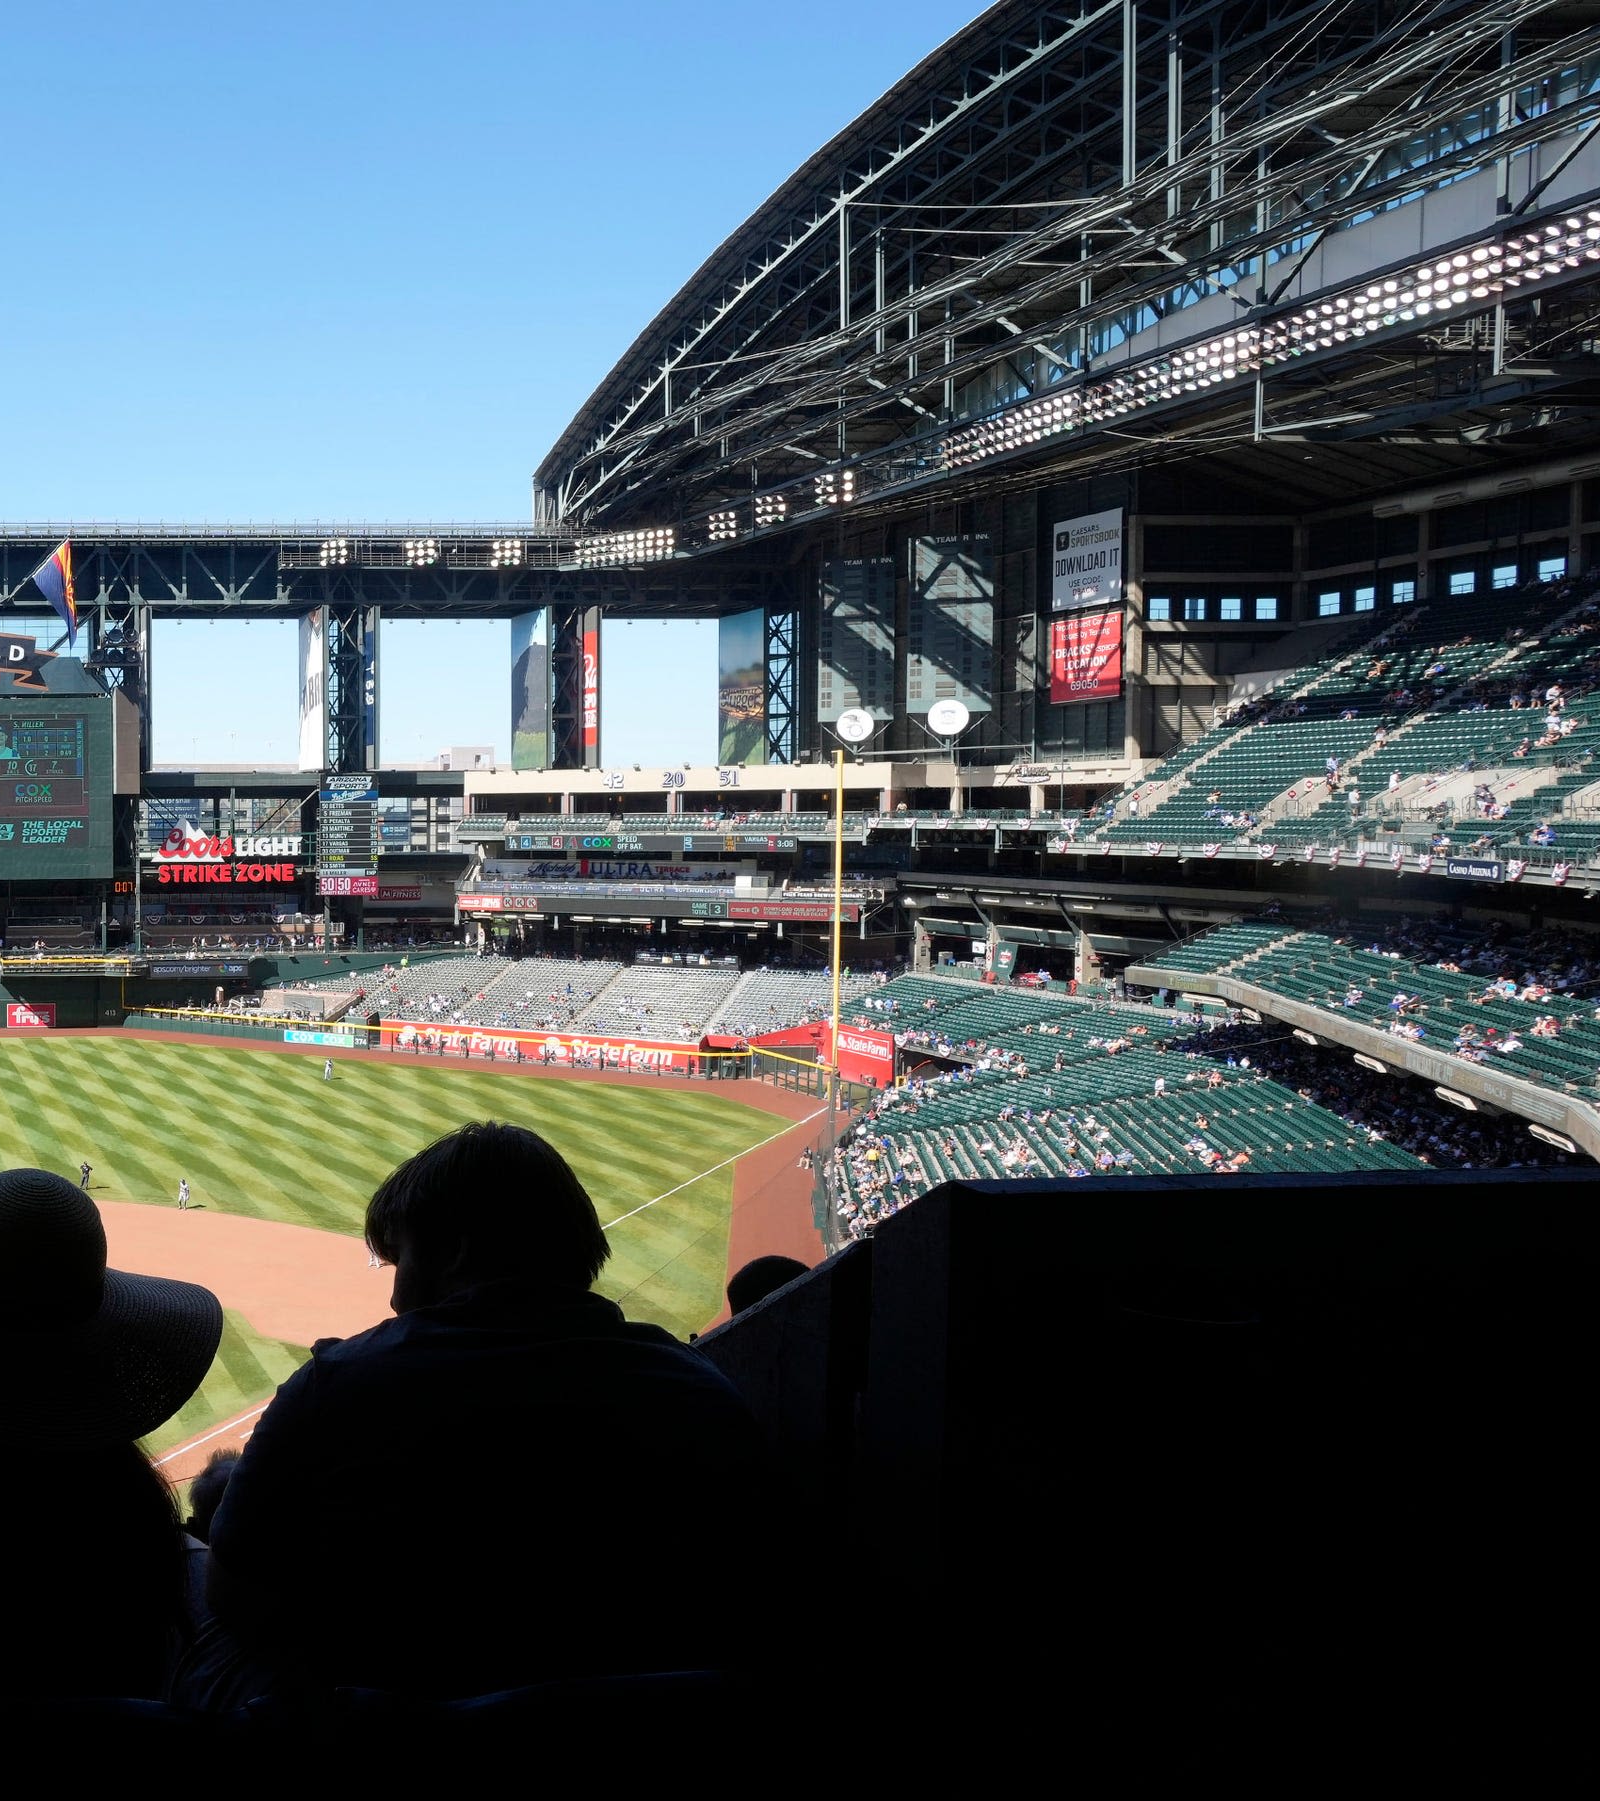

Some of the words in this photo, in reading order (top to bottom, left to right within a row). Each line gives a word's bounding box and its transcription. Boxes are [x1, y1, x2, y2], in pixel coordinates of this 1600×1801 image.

[1071, 525, 1099, 537] CAESARS
[1071, 529, 1120, 549] SPORTSBOOK
[844, 559, 863, 567] TEAM
[1055, 550, 1106, 578] DOWNLOAD
[1109, 548, 1120, 567] IT
[1069, 578, 1081, 588] USE
[1082, 575, 1104, 586] CODE:
[1055, 622, 1074, 632] Report
[1075, 620, 1091, 630] Guest
[1092, 615, 1118, 627] Conduct
[1063, 655, 1107, 671] LOCATION
[1070, 679, 1098, 690] 69050
[7, 761, 18, 770] 10
[51, 760, 58, 769] 7
[603, 771, 624, 789] 42
[662, 771, 686, 788] 20
[719, 770, 740, 787] 51
[15, 784, 52, 797] COX
[22, 821, 45, 829] THE
[47, 820, 83, 829] LOCAL
[22, 828, 67, 836] SPORTS
[159, 828, 236, 859] Coors
[235, 836, 303, 857] LIGHT
[583, 837, 613, 848] COX
[777, 840, 794, 848] 3:06
[157, 863, 232, 883] STRIKE
[235, 863, 295, 882] ZONE
[528, 862, 578, 874] Michelob
[589, 862, 652, 876] ULTRA
[655, 865, 691, 873] TERRACE
[1448, 862, 1468, 875] CASINO
[1468, 864, 1492, 877] ARIZONA
[114, 881, 133, 893] 0:07
[321, 878, 335, 891] 50
[337, 878, 351, 891] 50
[714, 905, 721, 913] 3
[228, 965, 243, 973] aps
[292, 1033, 315, 1041] COX
[323, 1034, 345, 1044] COX
